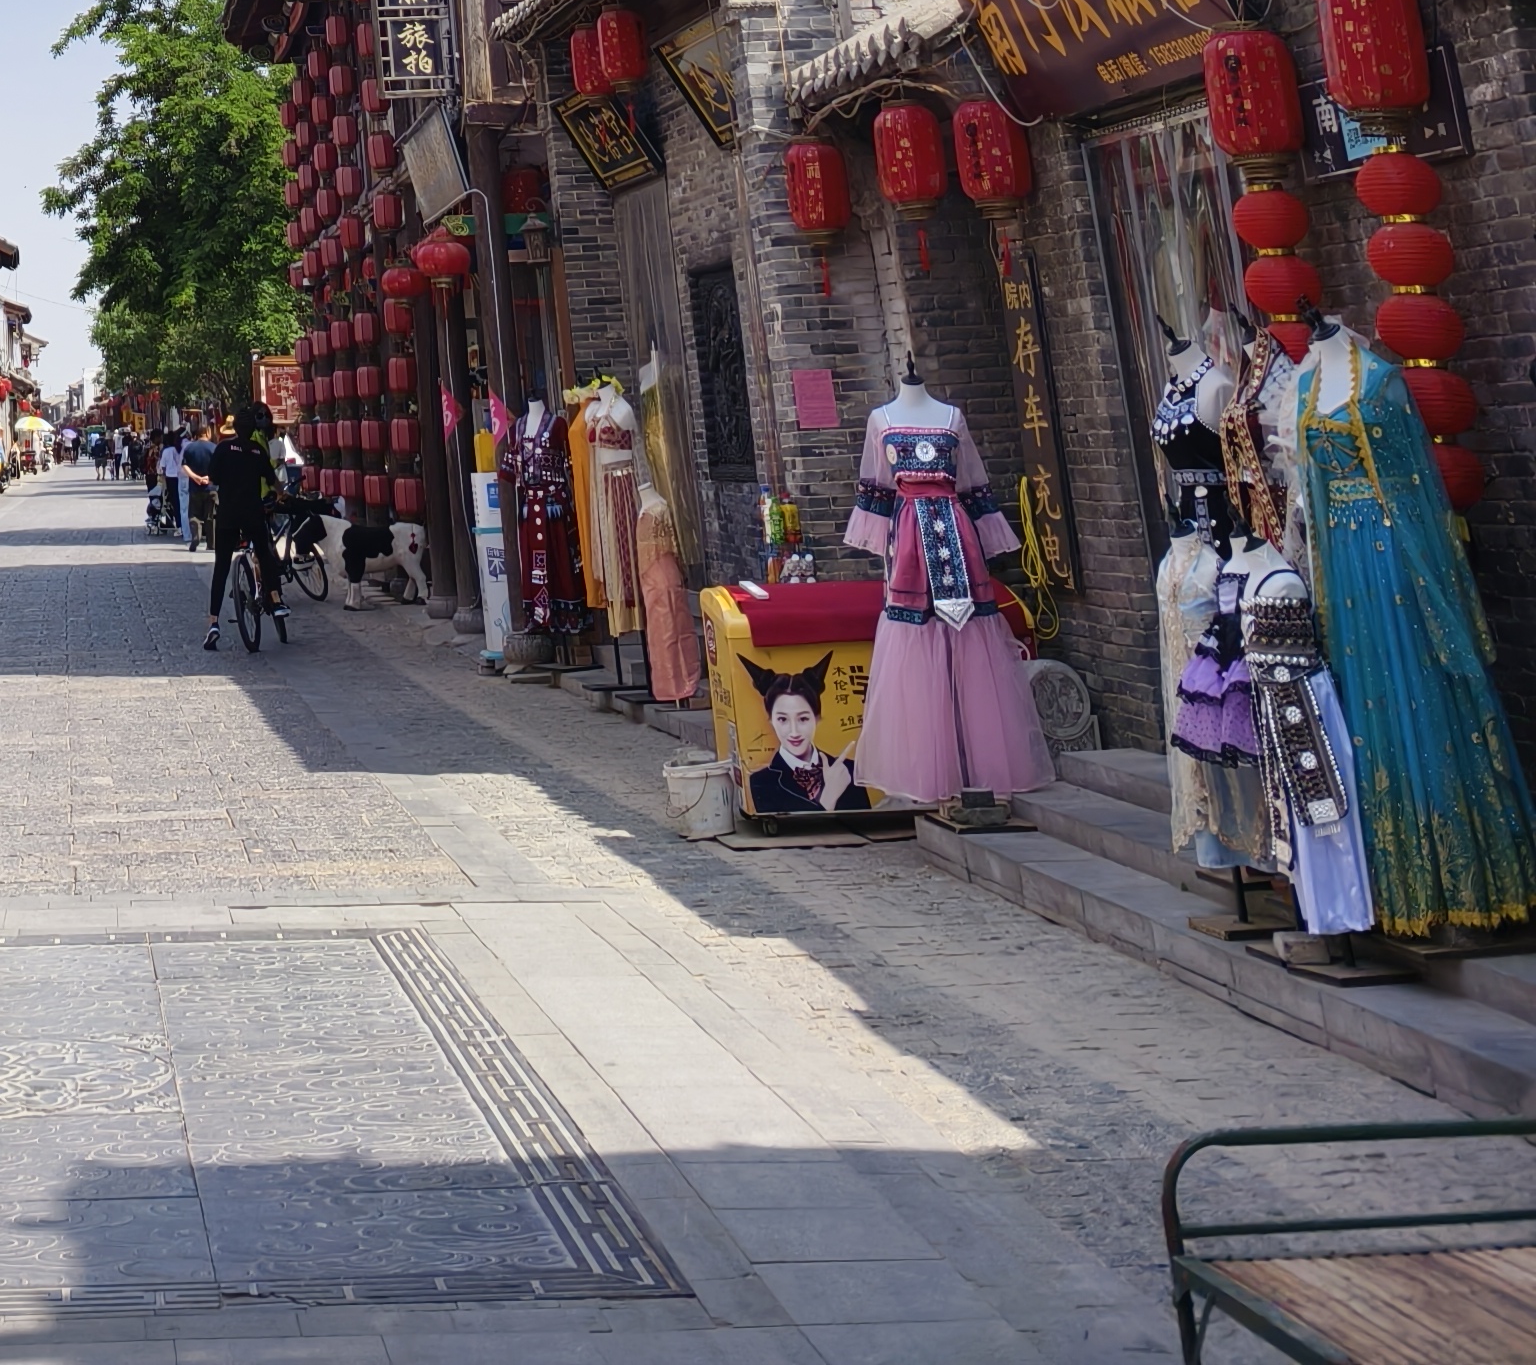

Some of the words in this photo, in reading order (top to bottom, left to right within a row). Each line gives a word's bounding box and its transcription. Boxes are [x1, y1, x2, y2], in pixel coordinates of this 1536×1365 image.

[1005, 281, 1032, 310] 院内
[1013, 316, 1069, 578] 存车充电
